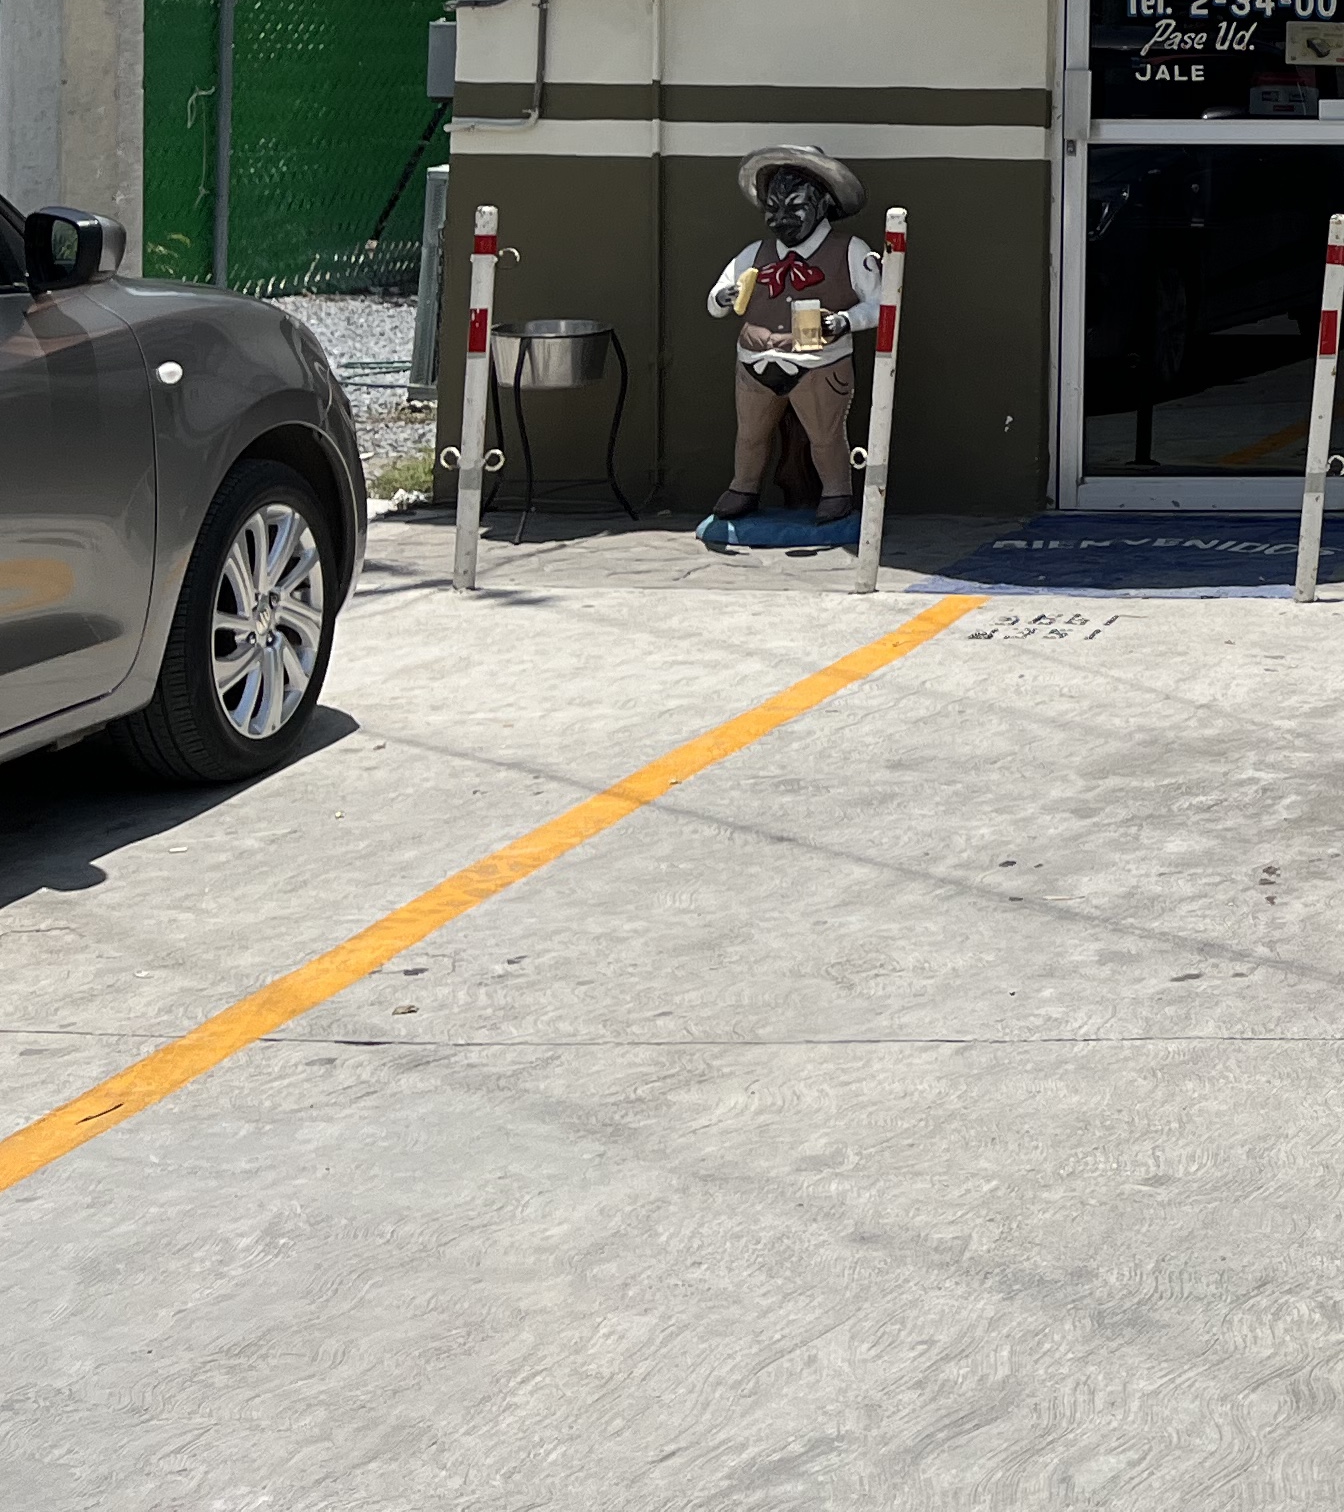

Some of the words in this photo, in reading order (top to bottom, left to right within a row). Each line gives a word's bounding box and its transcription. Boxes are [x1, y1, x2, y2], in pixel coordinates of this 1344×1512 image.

[1140, 19, 1207, 56] Pase
[1215, 21, 1258, 50] Ud.
[1135, 64, 1204, 81] JALE
